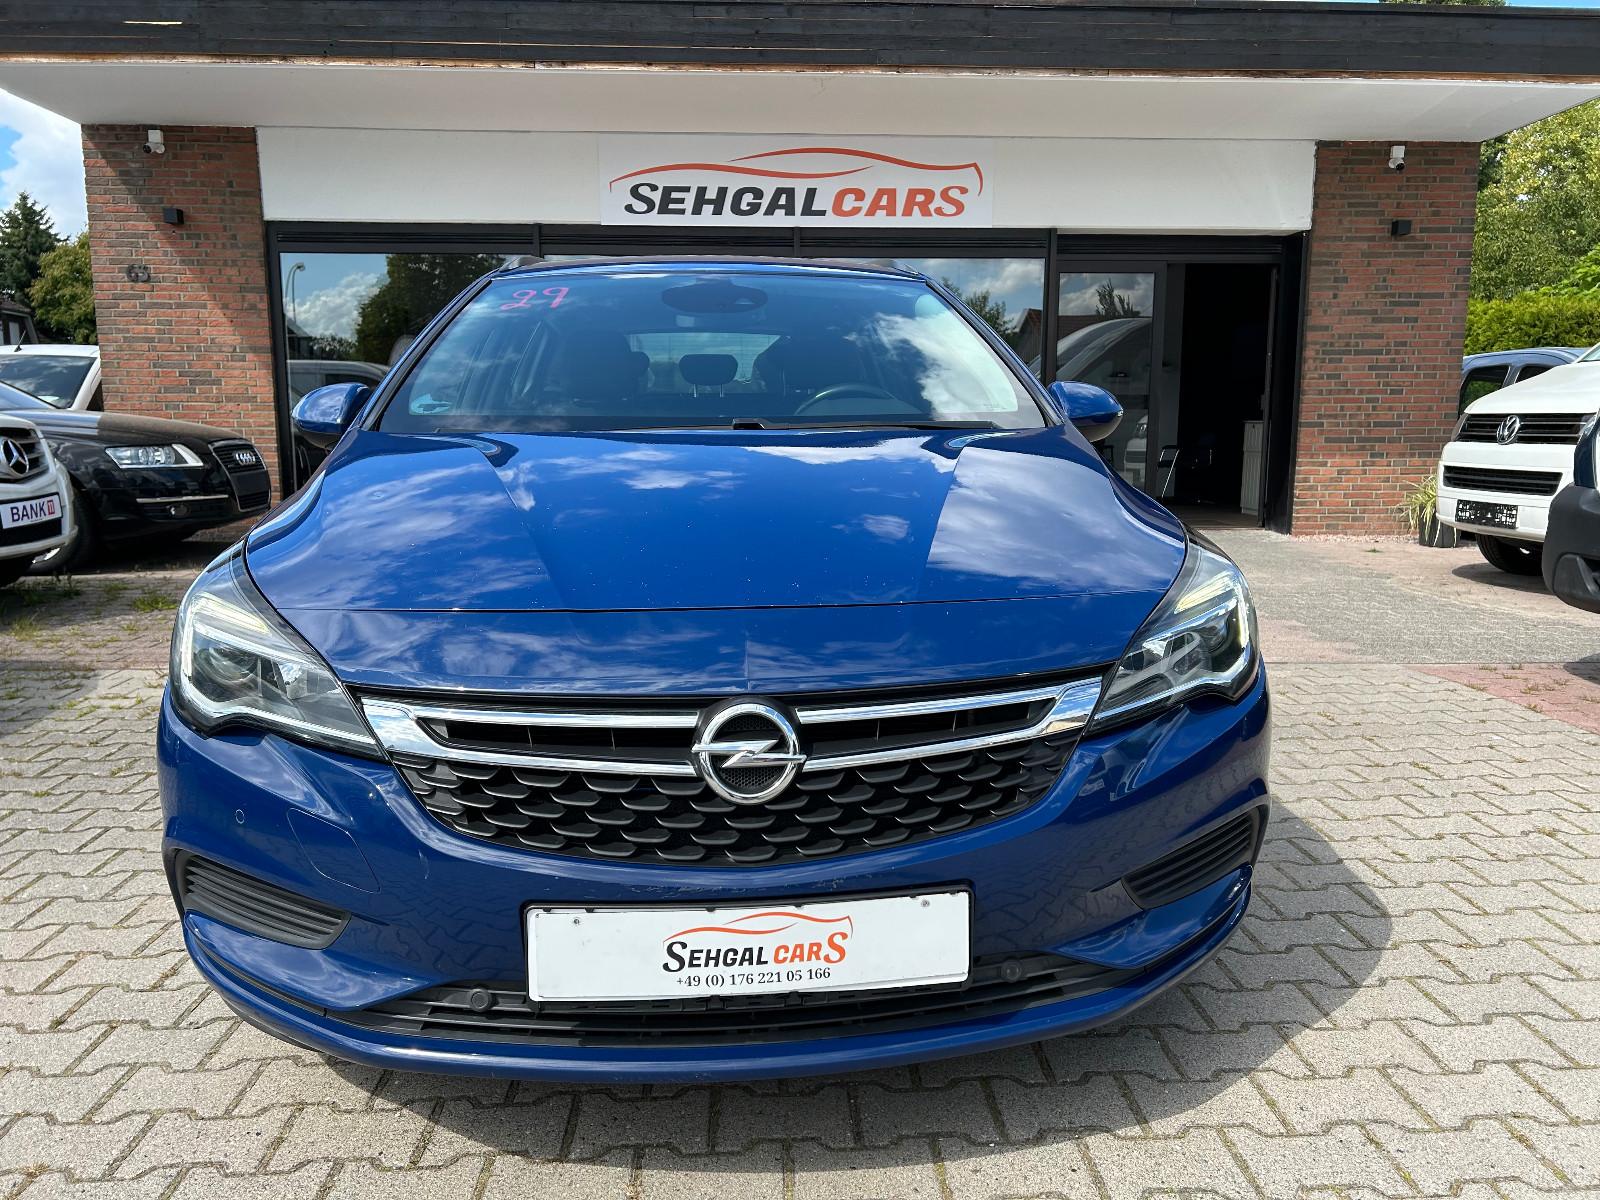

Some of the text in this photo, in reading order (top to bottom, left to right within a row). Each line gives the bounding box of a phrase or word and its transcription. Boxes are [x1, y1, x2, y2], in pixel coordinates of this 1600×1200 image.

[662, 941, 768, 973] SEHGAL
[676, 967, 831, 987] +49 (0) 176 221 05 166
